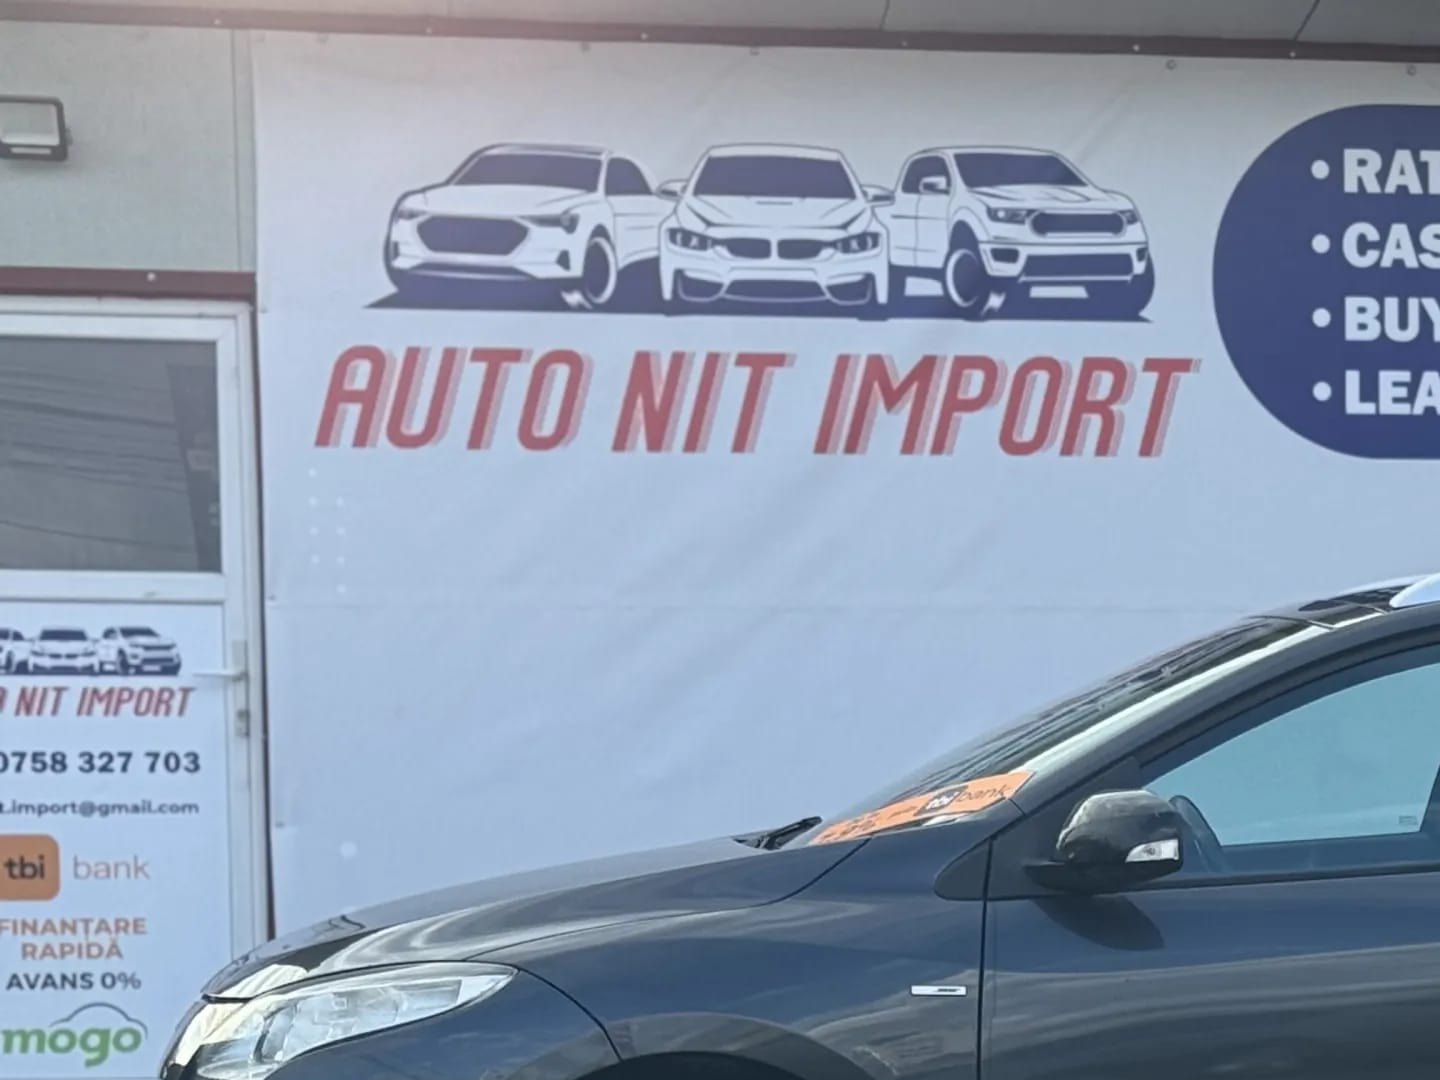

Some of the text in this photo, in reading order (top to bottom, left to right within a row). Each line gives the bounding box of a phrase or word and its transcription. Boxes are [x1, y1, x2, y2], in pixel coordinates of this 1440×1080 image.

[314, 345, 1202, 458] AUTO NIT IMPORT
[14, 685, 69, 717] NIT
[76, 685, 197, 718] IMPORT
[77, 751, 134, 774] 327
[144, 751, 201, 774] 703
[3, 854, 151, 880] tbi bank
[20, 937, 124, 960] RAPIDĂ
[6, 972, 142, 990] AVANS 0%
[1, 1027, 142, 1068] mogo
